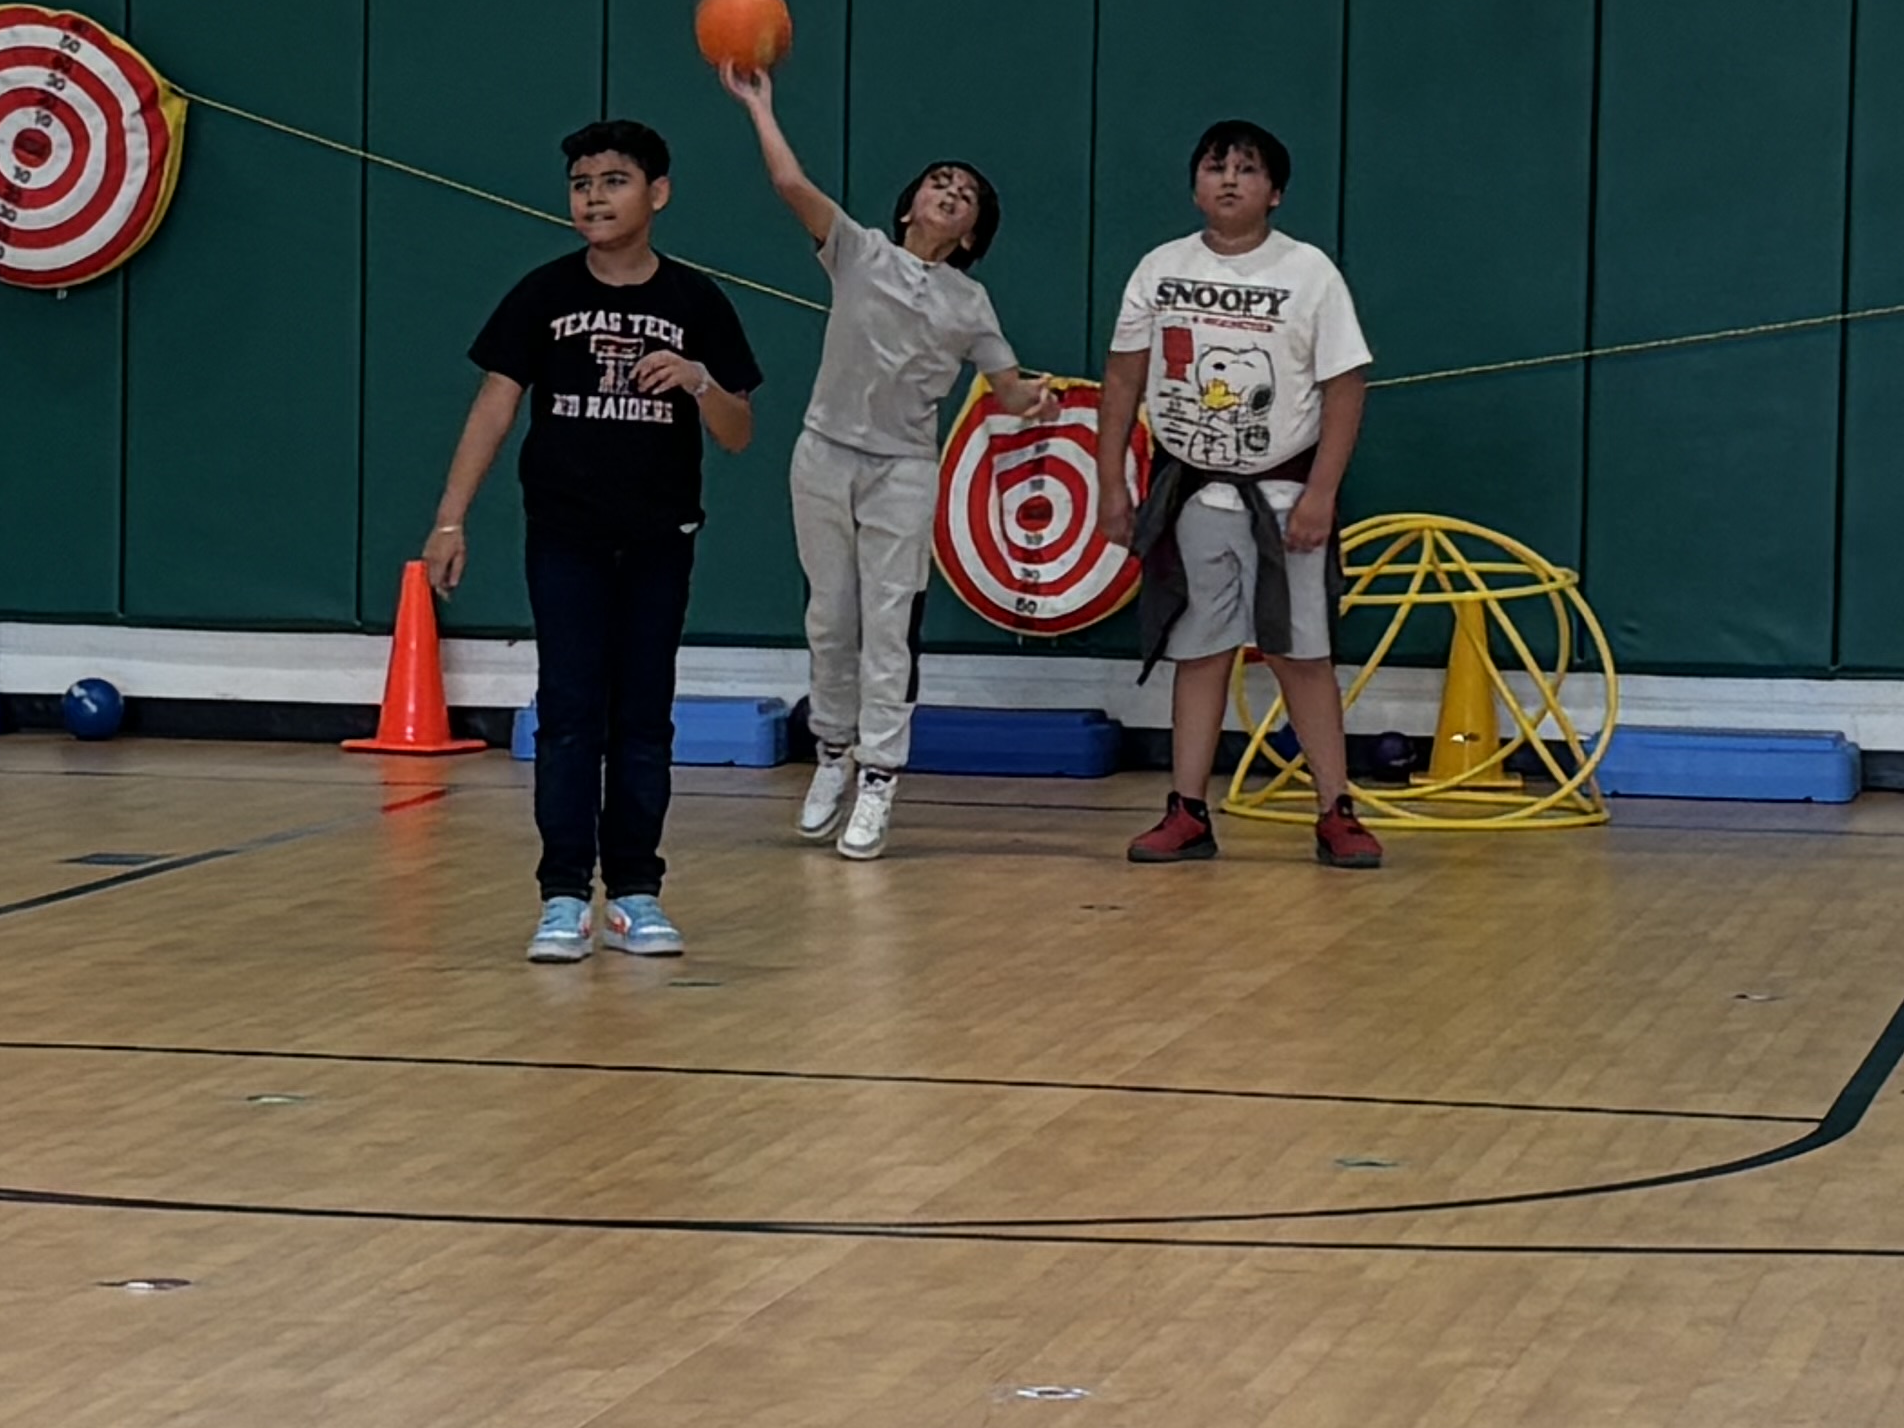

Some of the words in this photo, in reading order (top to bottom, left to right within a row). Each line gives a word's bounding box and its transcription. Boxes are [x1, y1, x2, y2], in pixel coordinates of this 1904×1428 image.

[1155, 281, 1290, 316] SNOOPY
[550, 309, 622, 341] TEXAS
[627, 313, 684, 351] TECH
[585, 395, 674, 424] RAIDERS
[1015, 597, 1038, 615] 50
